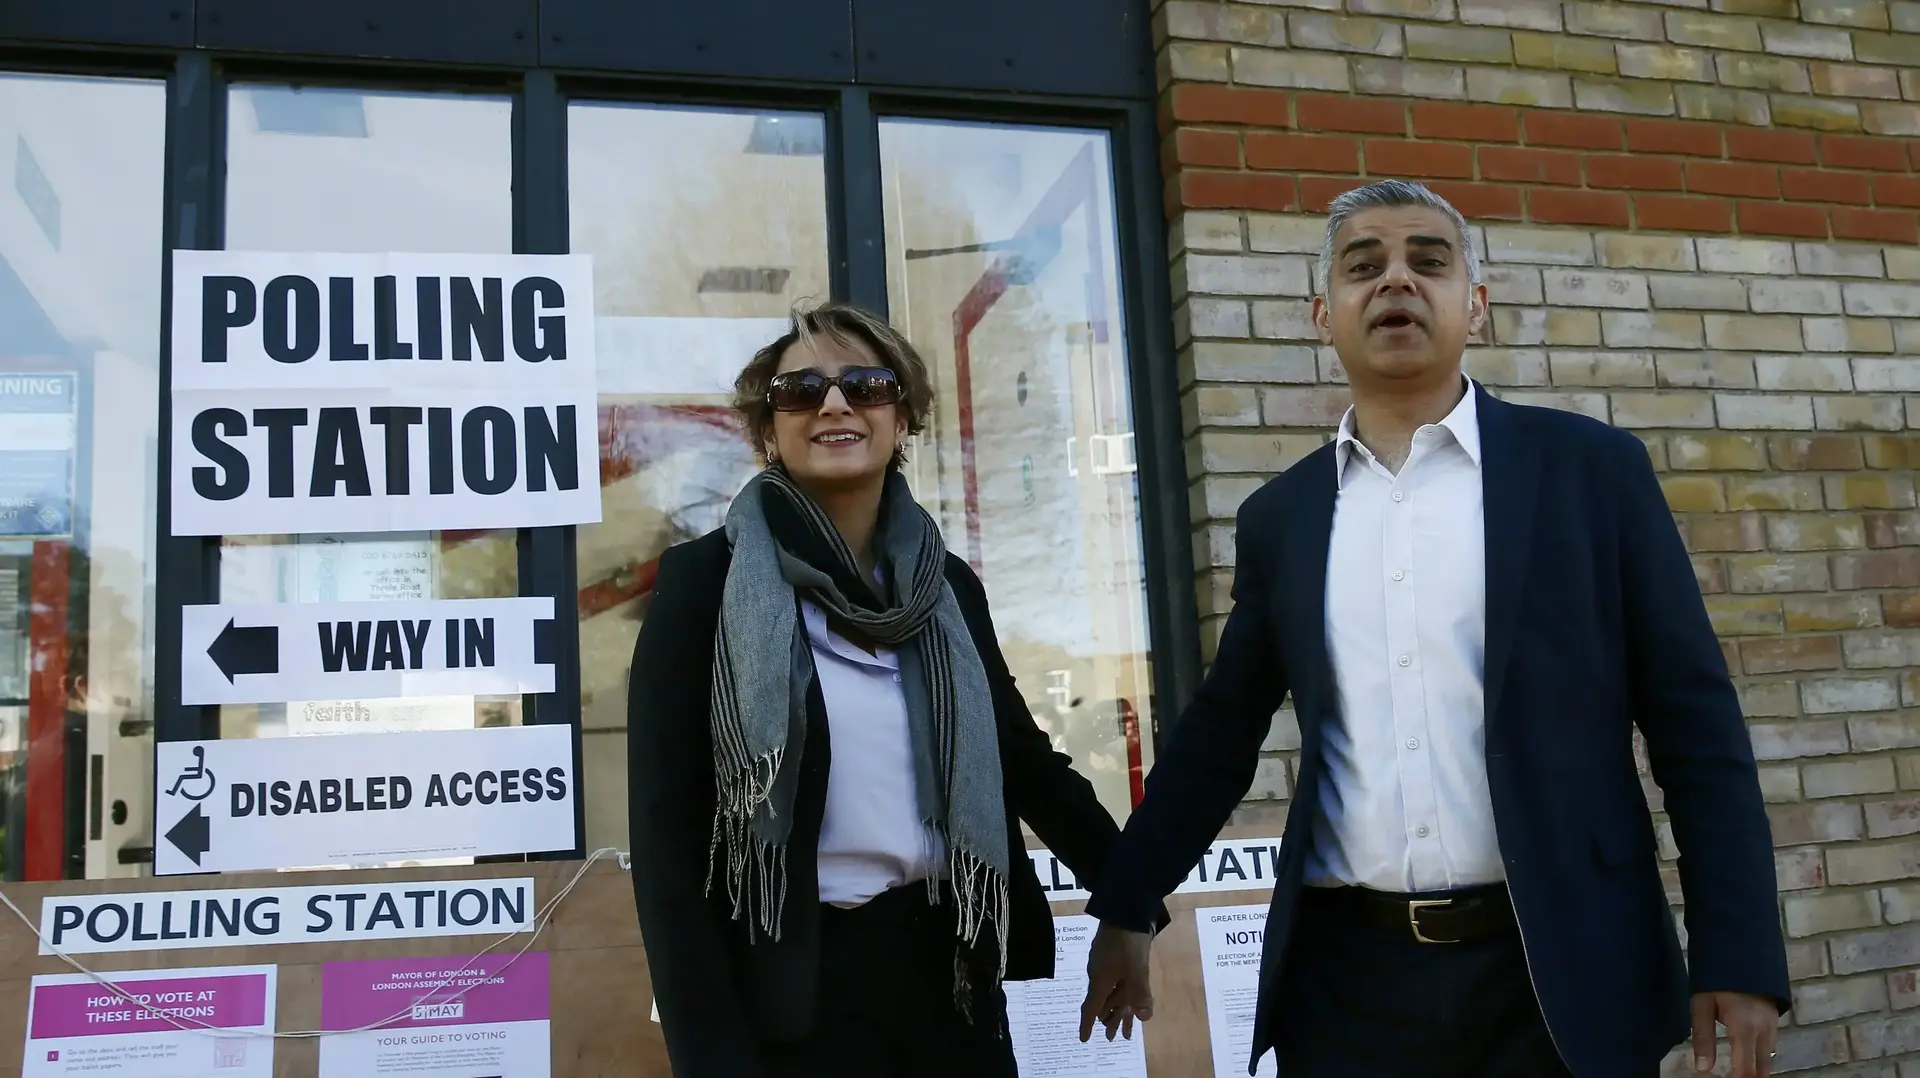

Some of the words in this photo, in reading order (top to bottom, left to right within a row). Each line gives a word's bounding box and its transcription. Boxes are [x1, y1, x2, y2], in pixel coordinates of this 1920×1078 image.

[202, 275, 567, 363] POLLING
[0, 379, 62, 395] NING
[192, 405, 579, 500] STATION
[318, 620, 432, 672] WAY
[446, 618, 495, 668] IN
[303, 702, 370, 722] faith
[231, 776, 412, 818] DISABLED
[425, 767, 567, 808] ACCESS
[52, 897, 281, 945] POLLING
[306, 886, 526, 933] STATION
[1211, 913, 1247, 923] GREATER
[1249, 912, 1269, 920] LOND
[1226, 931, 1263, 945] NOTI
[1217, 953, 1246, 961] ELECTION
[372, 982, 411, 991] LONDON
[413, 979, 455, 989] ASSEMBLY
[458, 976, 505, 986] ELECTIONS
[392, 971, 423, 980] MAYOR
[425, 971, 437, 979] OF
[439, 970, 477, 978] LONDON
[87, 996, 124, 1008] HOW
[132, 994, 151, 1005] TO
[156, 992, 193, 1003] VOTE
[197, 990, 216, 1001] AT
[86, 1011, 131, 1023] THESE
[136, 1005, 215, 1020] ELECTIONS
[415, 1007, 422, 1018] 5
[429, 1005, 460, 1017] MAY
[377, 1036, 407, 1046] YOUR
[411, 1034, 445, 1045] GUIDE
[448, 1034, 462, 1043] TO
[465, 1031, 507, 1041] VOTING
